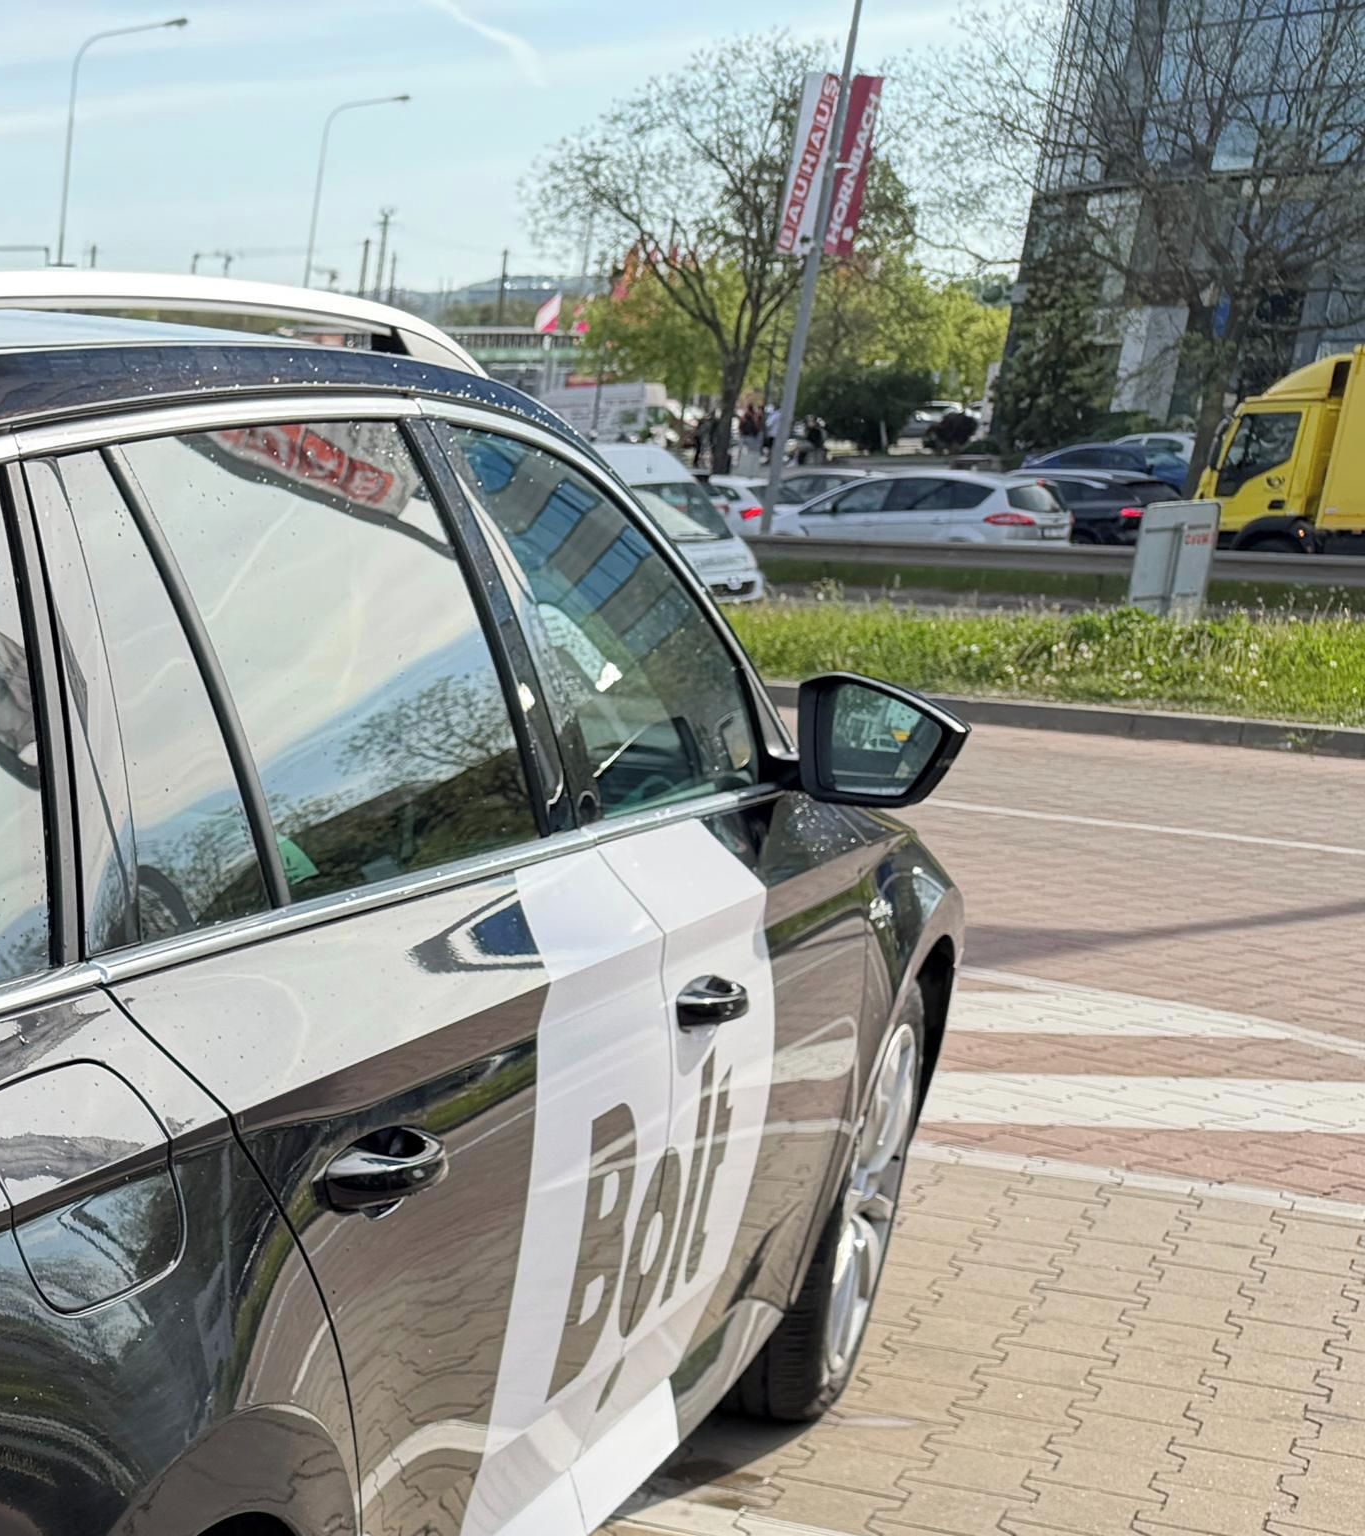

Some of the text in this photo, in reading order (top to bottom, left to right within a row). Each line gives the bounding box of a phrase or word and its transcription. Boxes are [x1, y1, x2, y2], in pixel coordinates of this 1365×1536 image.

[778, 75, 841, 250] BAUHAUS
[825, 92, 881, 245] HORNBACH
[545, 1046, 733, 1412] Bolt
